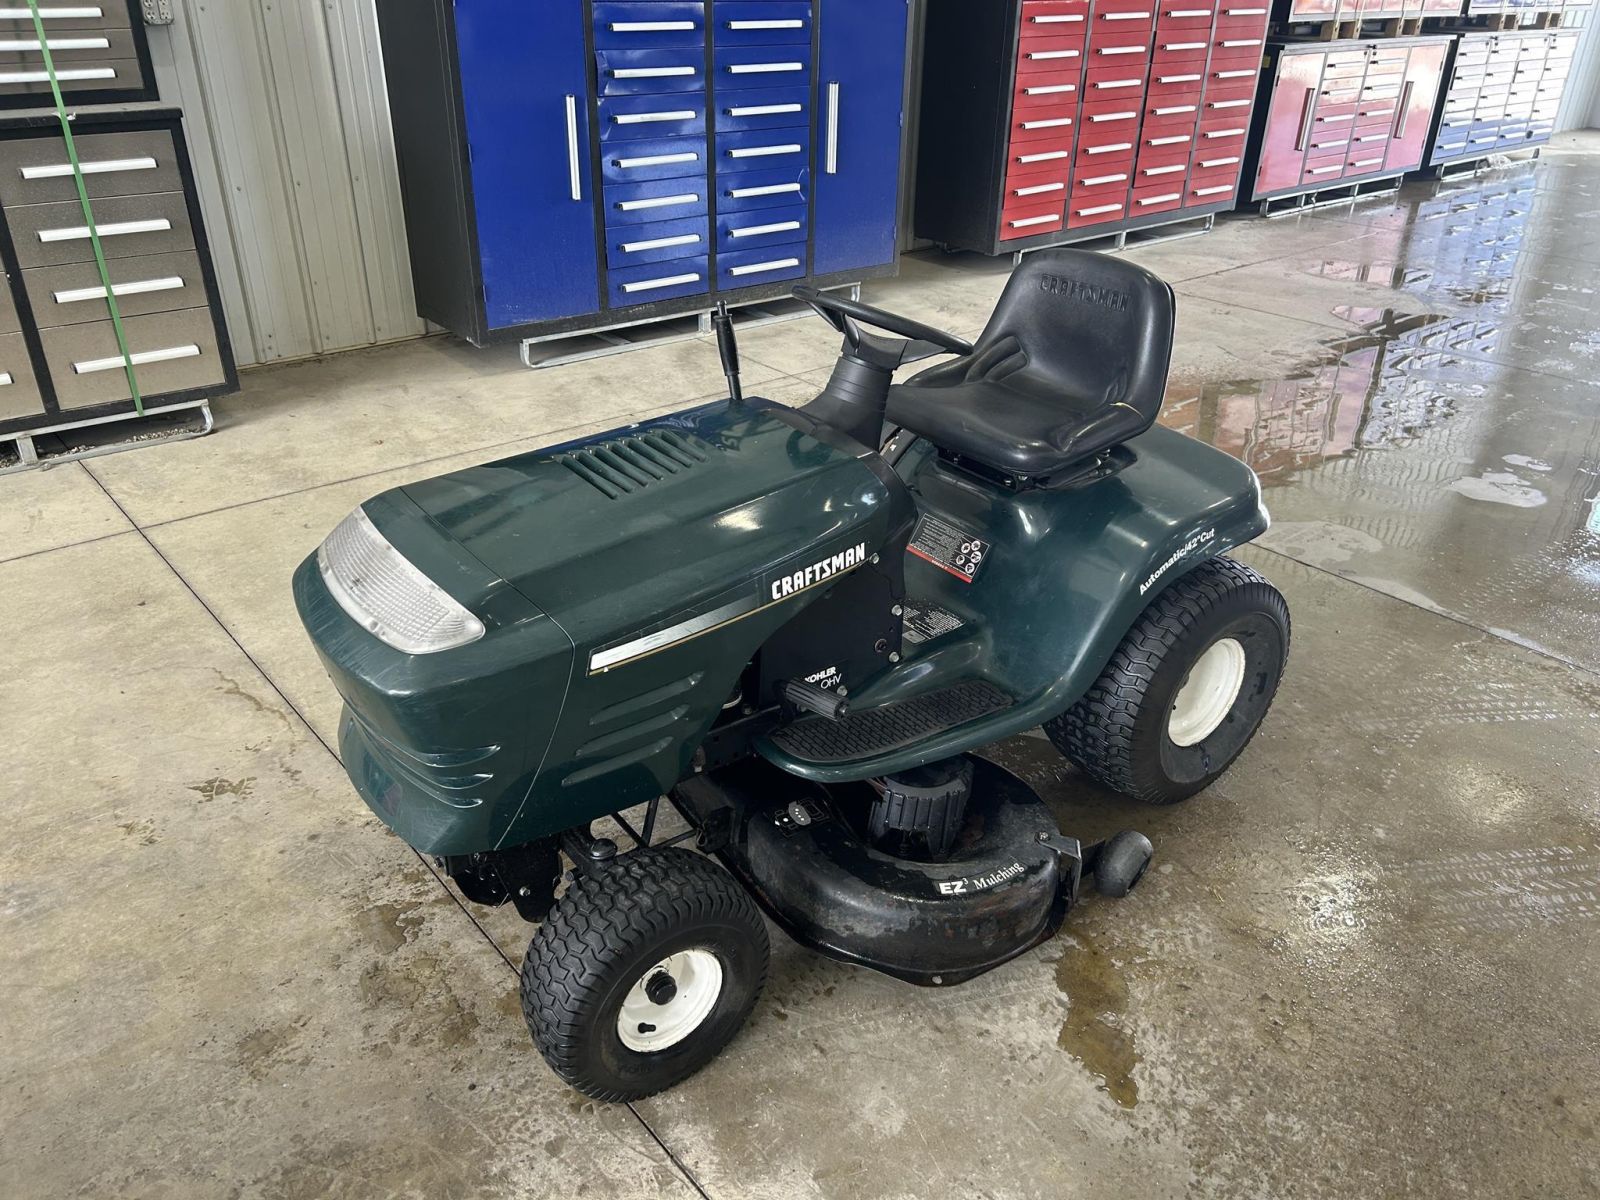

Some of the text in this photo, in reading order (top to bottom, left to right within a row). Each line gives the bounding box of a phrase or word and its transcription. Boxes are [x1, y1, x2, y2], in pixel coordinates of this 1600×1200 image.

[1041, 274, 1129, 312] CRAFTSMAN
[771, 542, 866, 600] CRAFTSMAN
[820, 673, 842, 690] OHV
[972, 862, 1025, 890] Mulching
